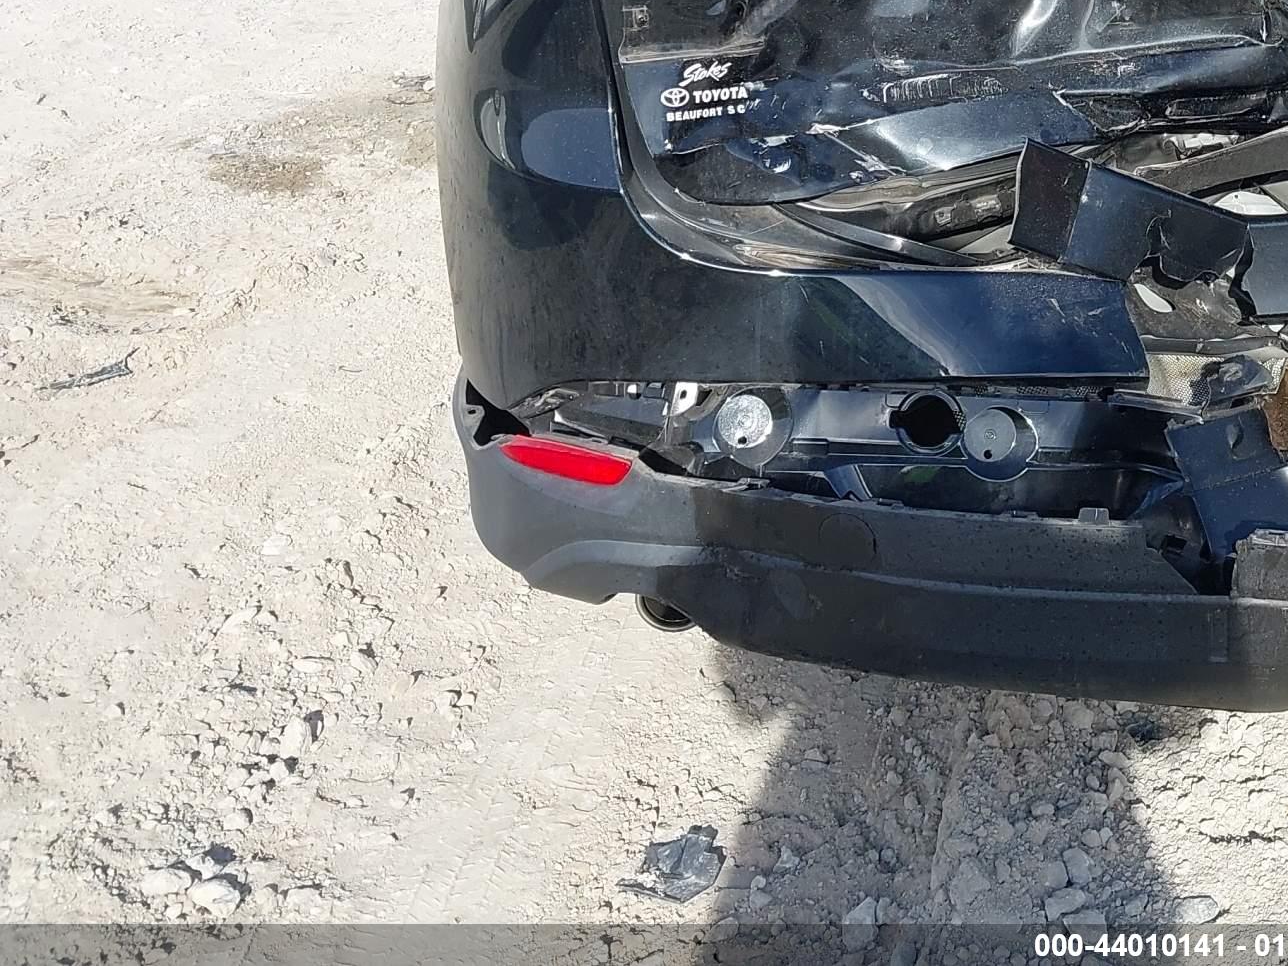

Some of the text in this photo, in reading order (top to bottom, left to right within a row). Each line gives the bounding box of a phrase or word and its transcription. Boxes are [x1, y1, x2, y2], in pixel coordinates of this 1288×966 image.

[678, 61, 732, 87] Stokes
[692, 86, 748, 104] TOYOTA
[666, 106, 723, 122] BEAUFORT
